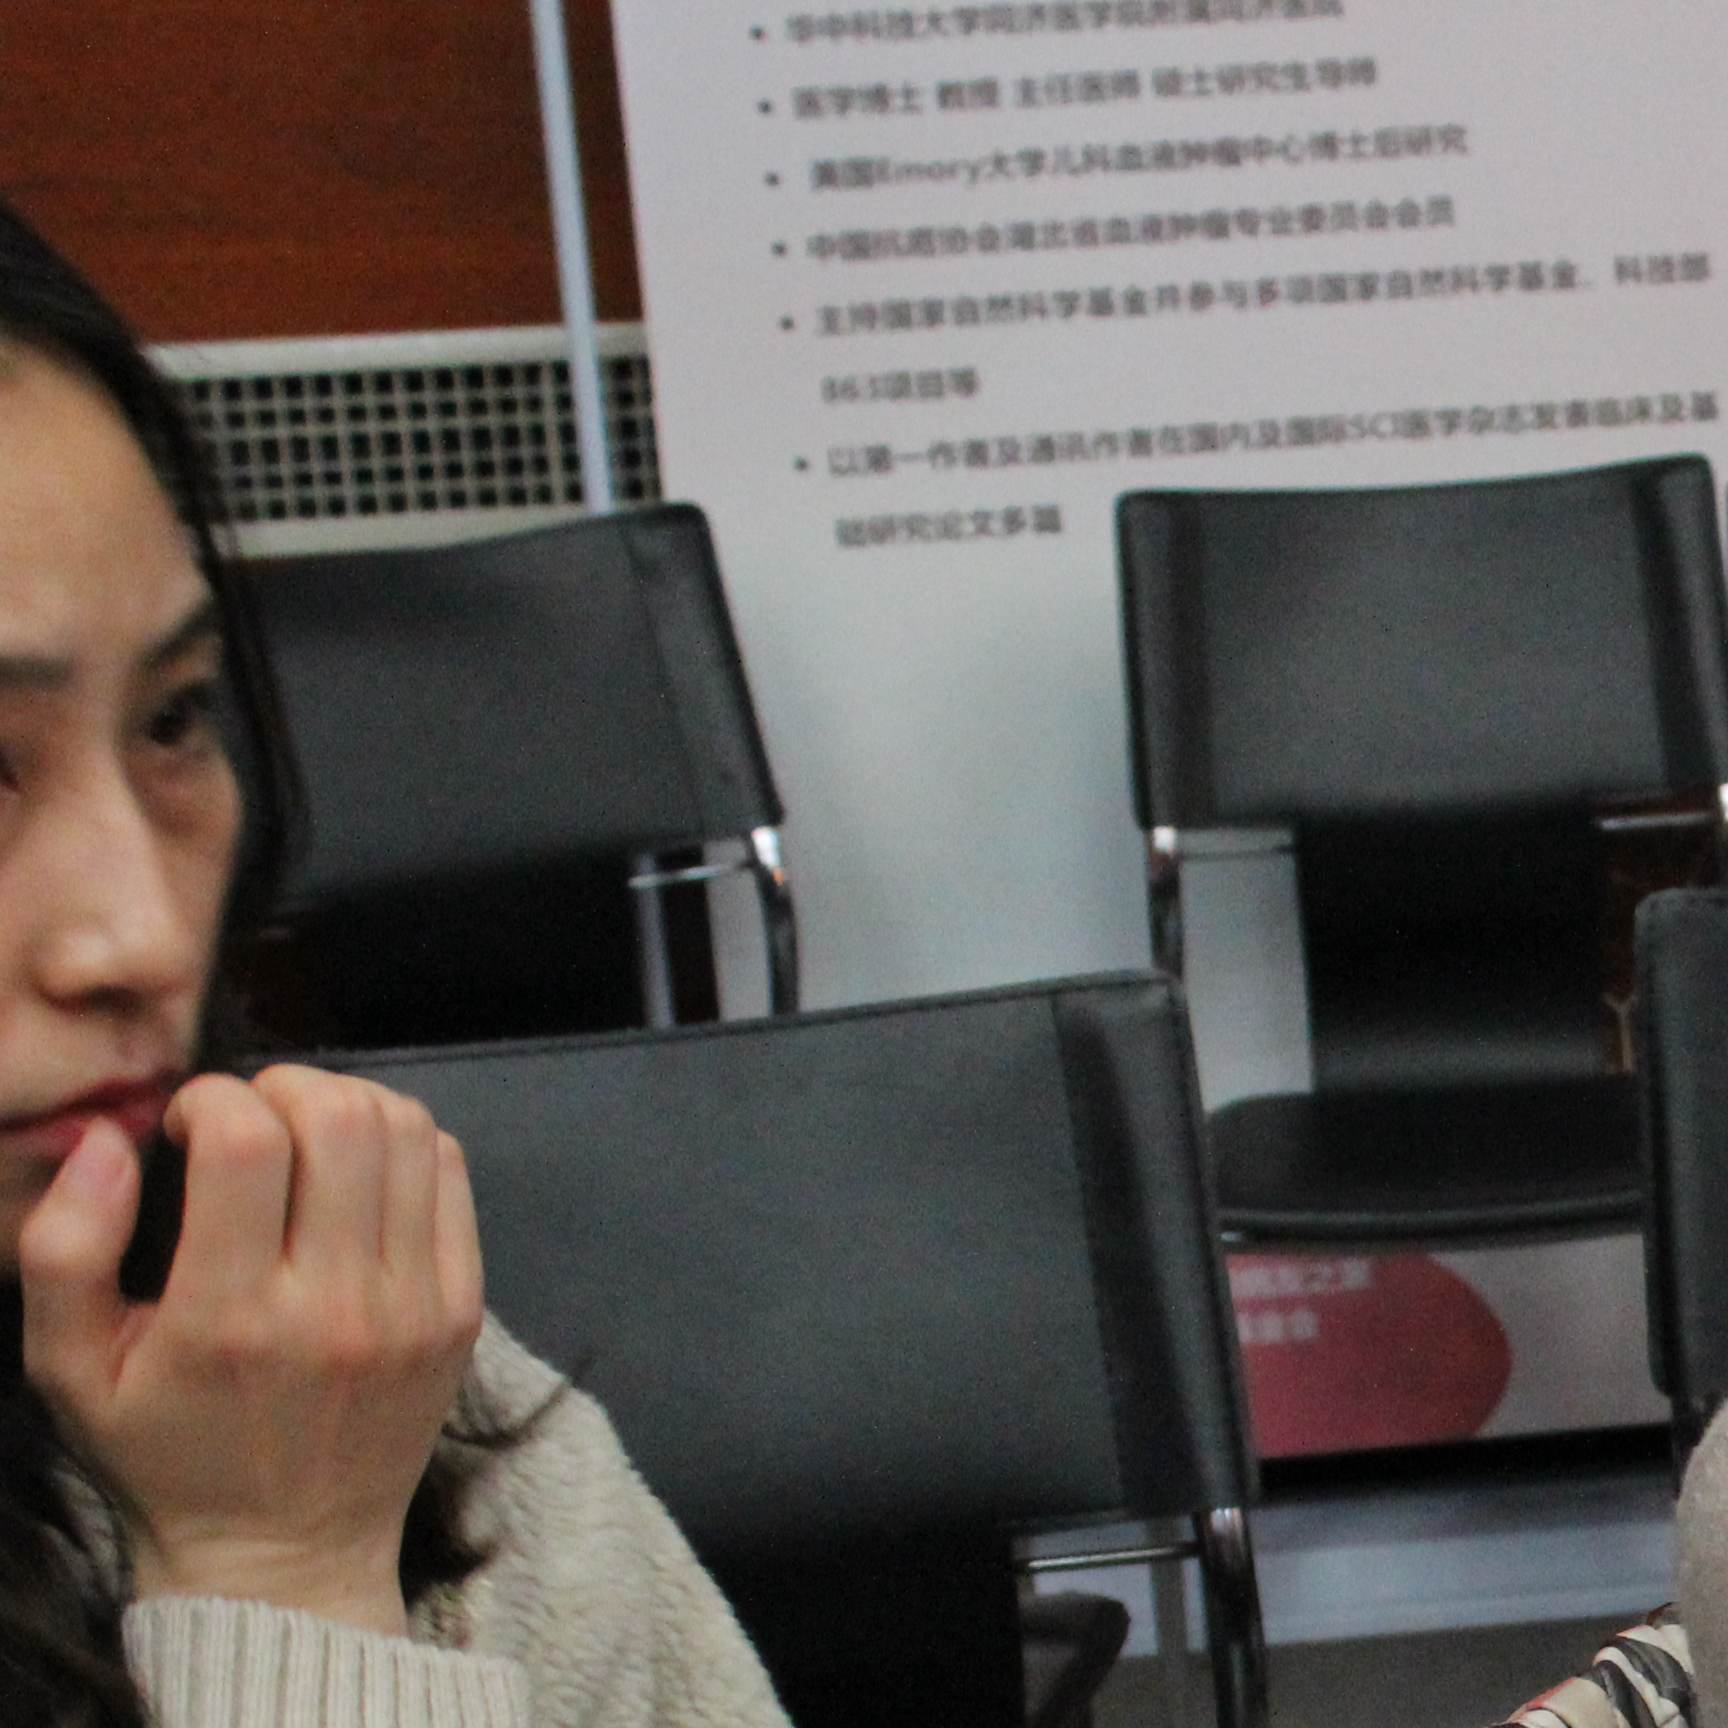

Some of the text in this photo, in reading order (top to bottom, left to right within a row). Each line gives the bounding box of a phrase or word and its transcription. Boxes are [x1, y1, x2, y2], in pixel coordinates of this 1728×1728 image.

[794, 81, 924, 119] 医学博士
[1013, 68, 1141, 108] 主任医师
